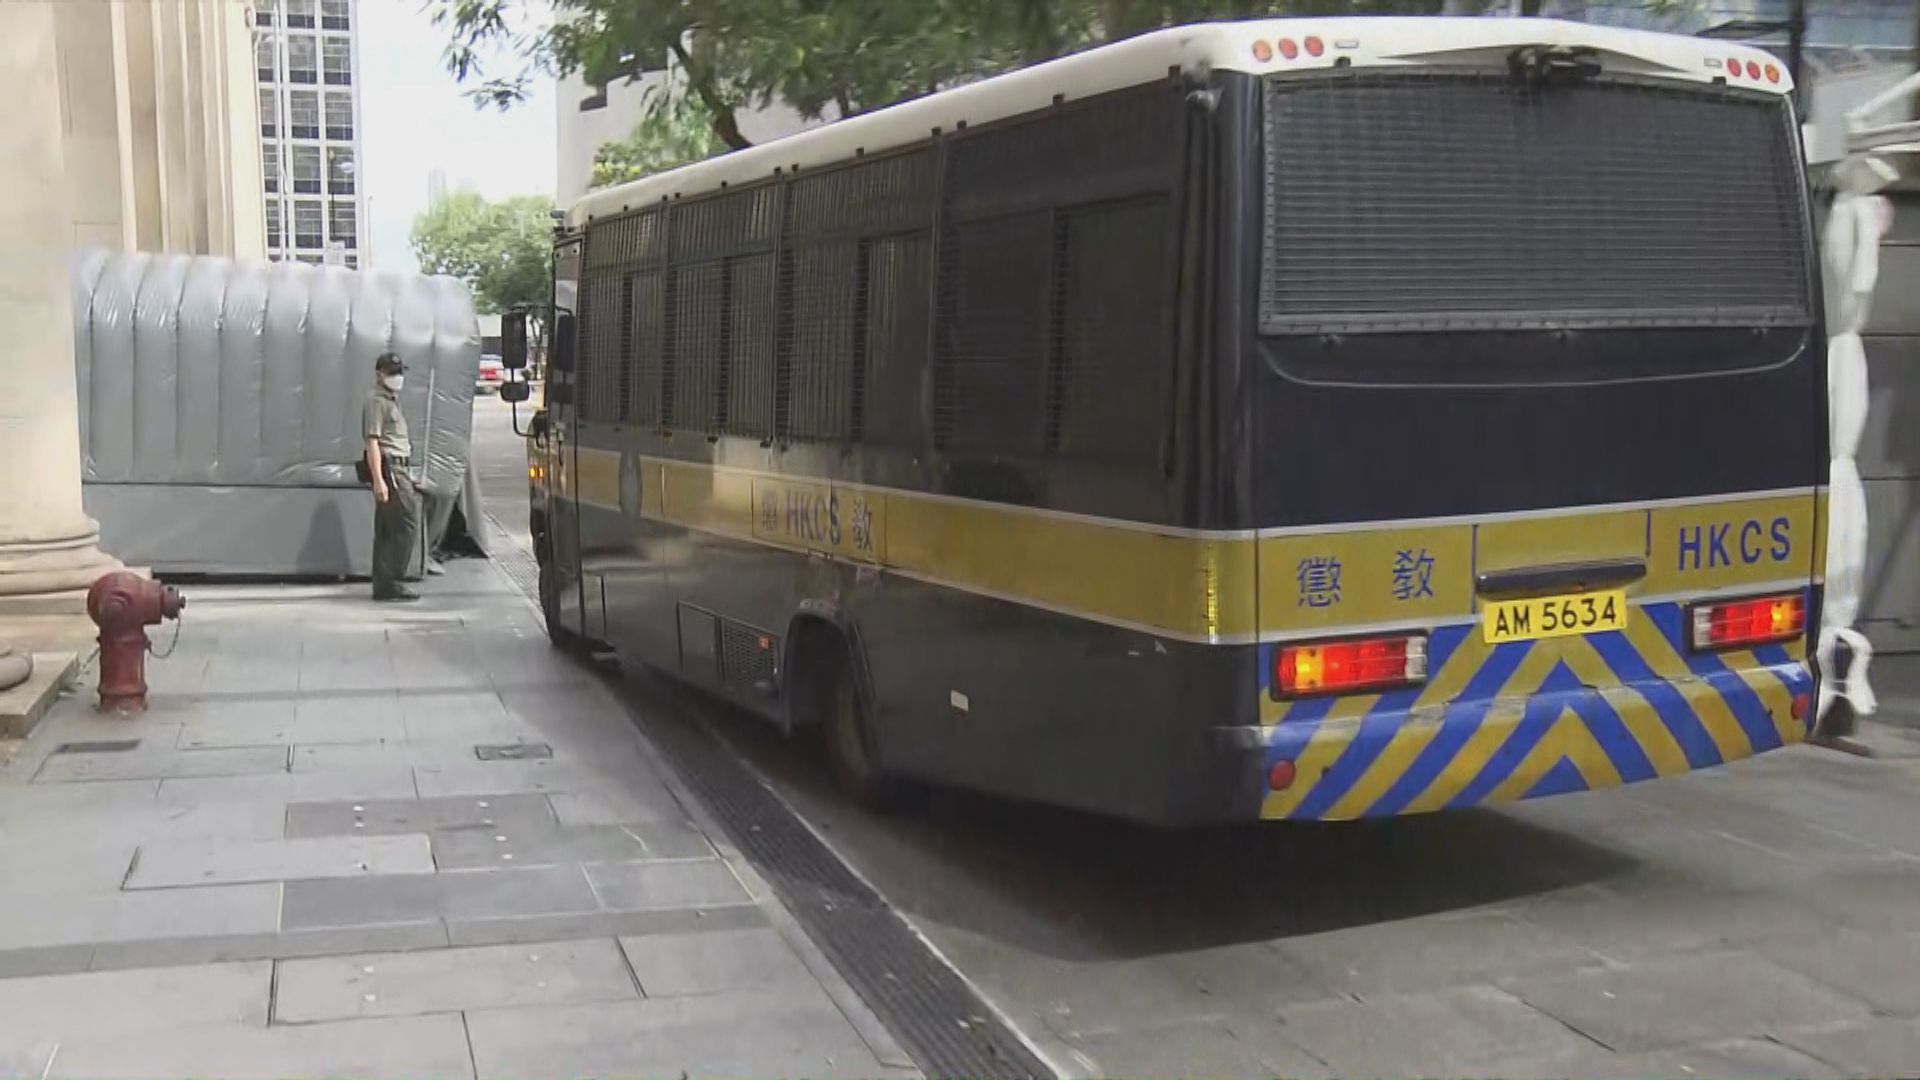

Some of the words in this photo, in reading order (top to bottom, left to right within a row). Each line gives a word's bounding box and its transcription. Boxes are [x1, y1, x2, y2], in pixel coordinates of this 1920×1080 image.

[785, 488, 841, 545] HKCS
[1678, 516, 1791, 571] HKCS
[1494, 605, 1532, 637] AM
[1541, 596, 1617, 631] 5634
